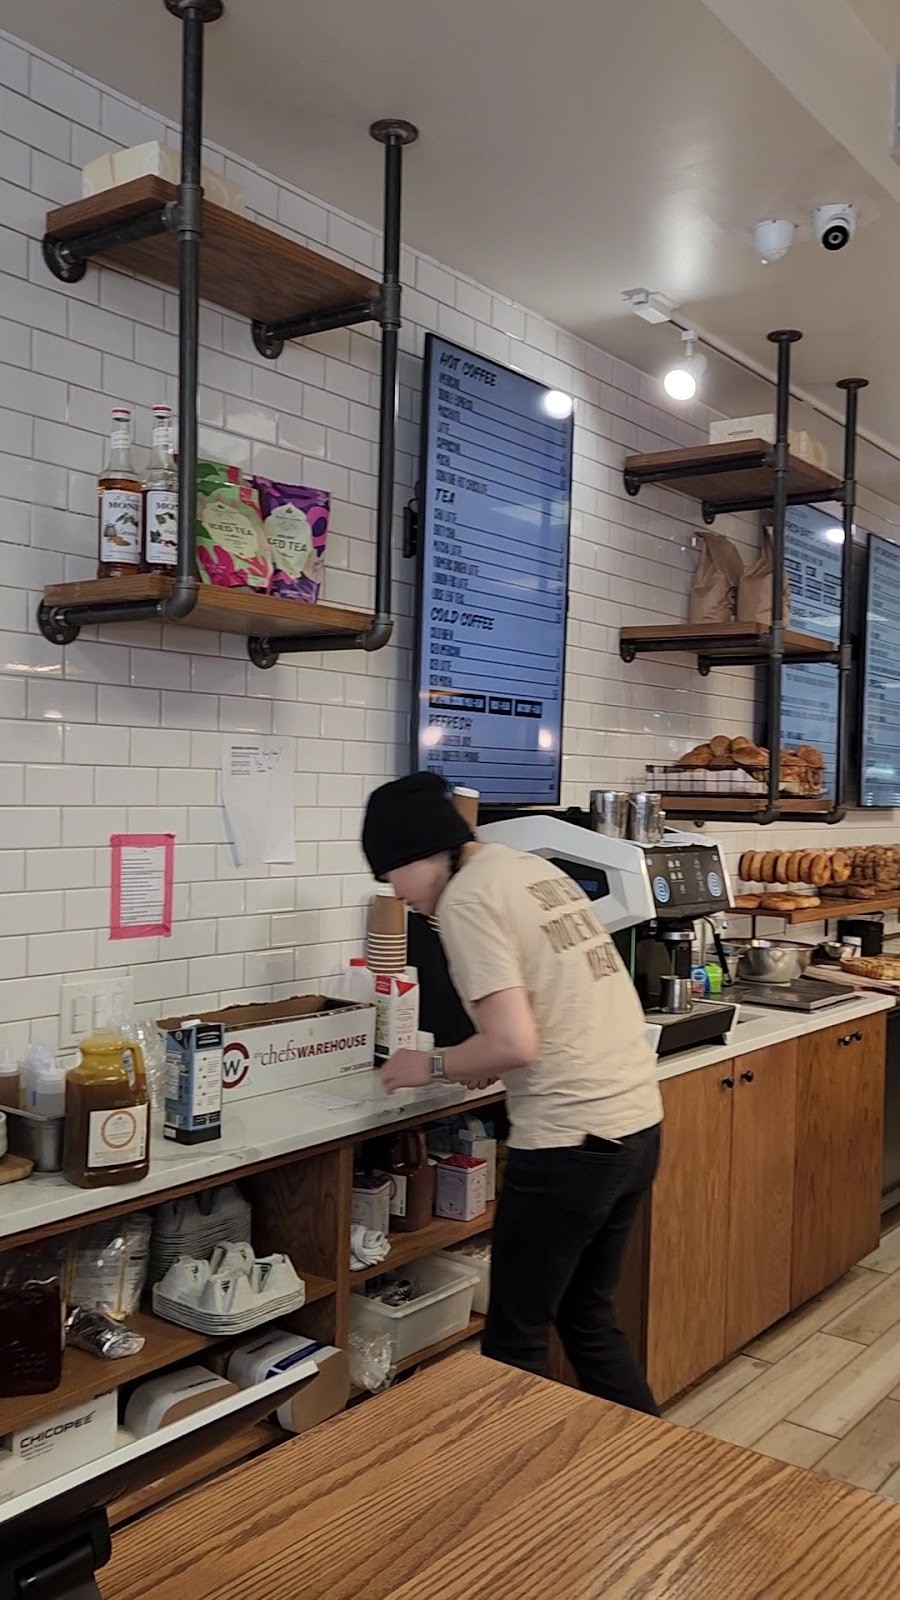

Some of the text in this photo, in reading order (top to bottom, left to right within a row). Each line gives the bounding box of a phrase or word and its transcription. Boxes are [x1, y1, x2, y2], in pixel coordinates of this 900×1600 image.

[440, 352, 461, 370] HOT
[462, 362, 498, 386] COFFEE
[435, 488, 455, 504] TEA
[208, 522, 254, 536] ICED TEA
[266, 537, 307, 552] CED TEA
[430, 606, 496, 631] COLD COFFEE
[20, 1410, 96, 1448] CHICOPEE
